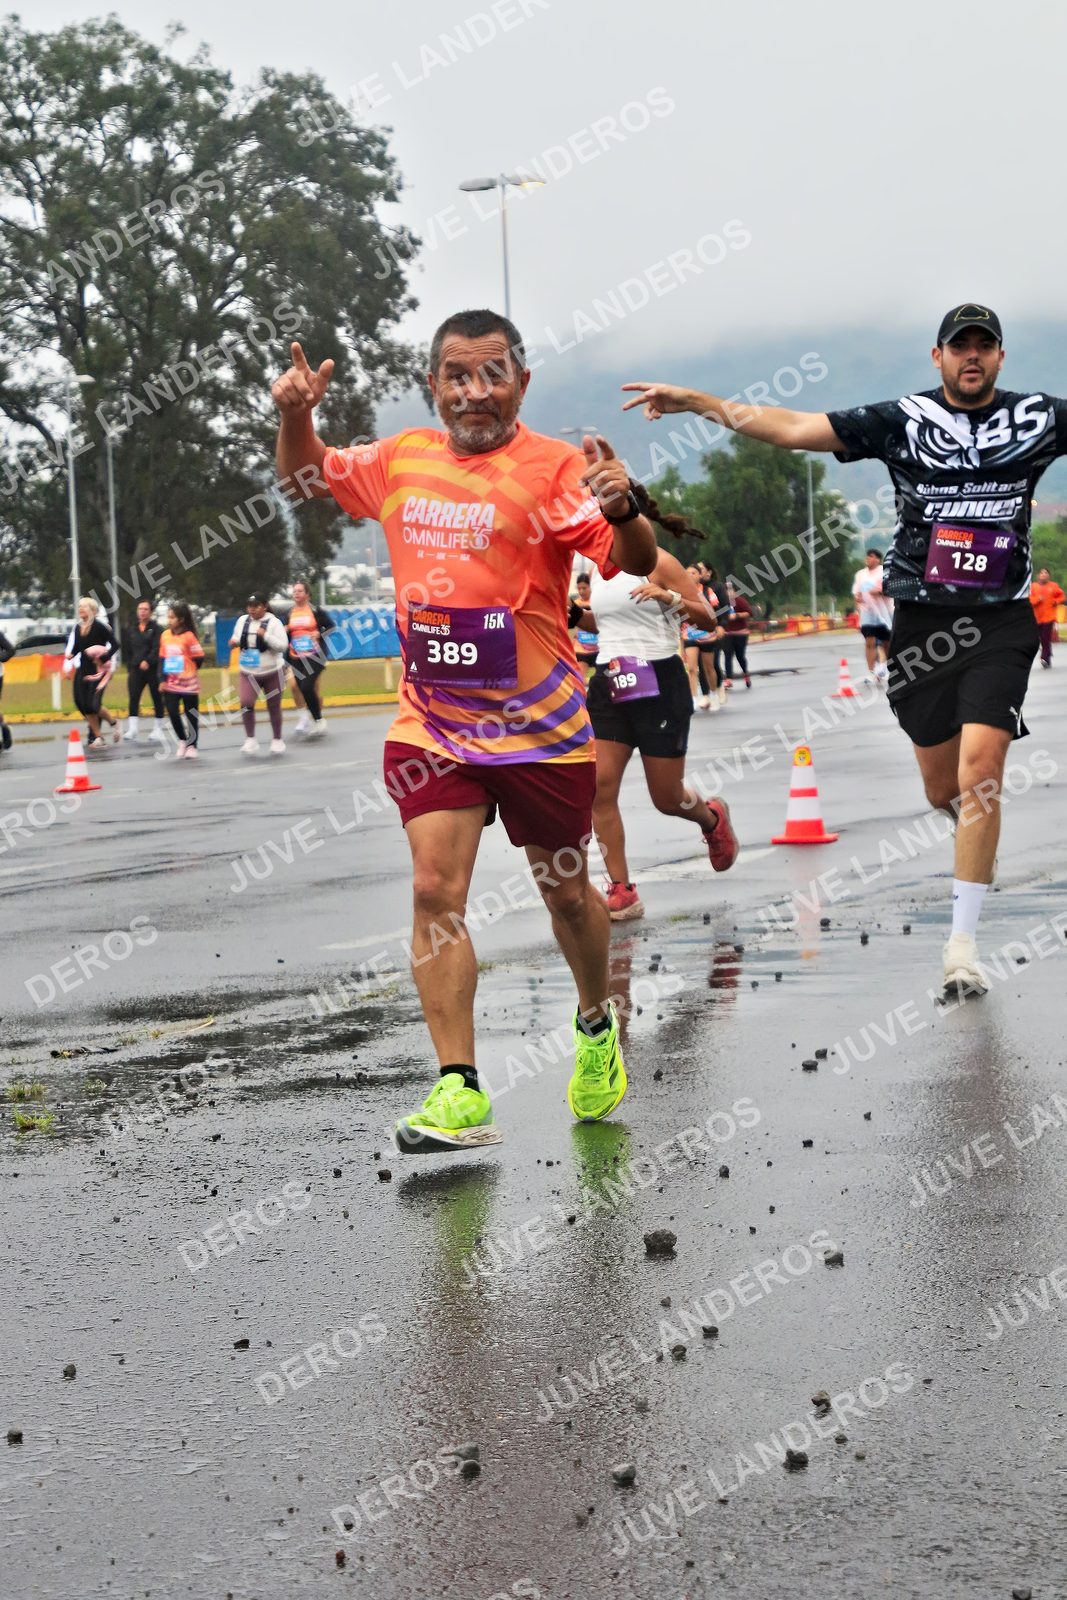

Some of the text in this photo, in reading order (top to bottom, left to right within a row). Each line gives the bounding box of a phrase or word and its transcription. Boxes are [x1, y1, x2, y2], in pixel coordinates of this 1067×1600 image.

[976, 395, 1048, 450] BS
[403, 496, 495, 529] CARRERA
[924, 496, 1023, 518] runner
[403, 526, 469, 549] OMNILIFE
[937, 528, 974, 543] CARRERA
[994, 536, 1010, 549] 15K
[952, 551, 988, 572] 128
[412, 609, 451, 625] CARRERA
[484, 612, 505, 630] 15K
[427, 640, 478, 665] 389
[613, 672, 637, 689] 189
